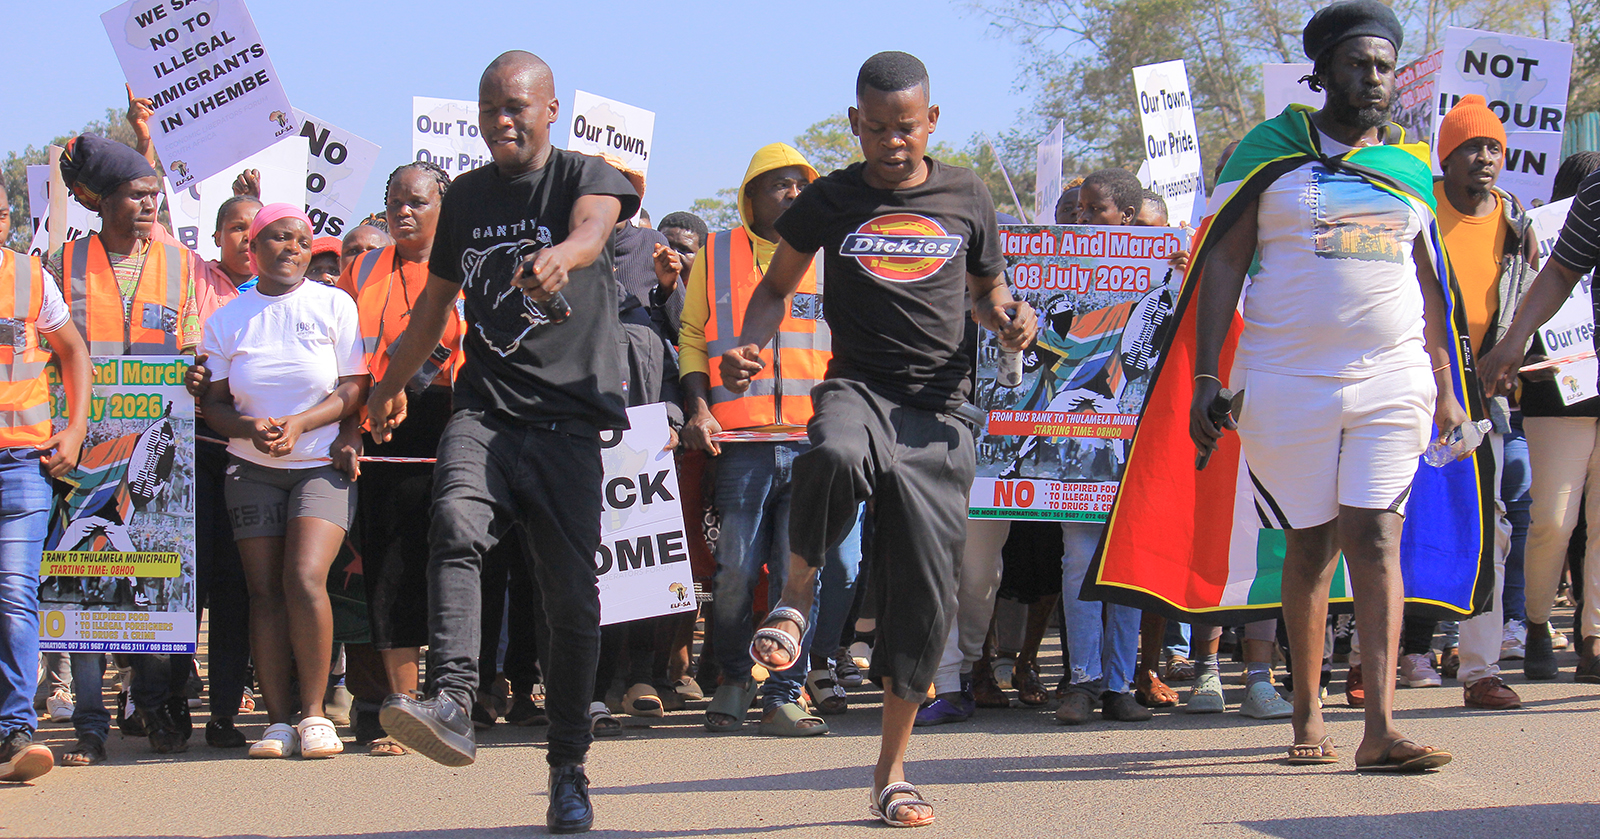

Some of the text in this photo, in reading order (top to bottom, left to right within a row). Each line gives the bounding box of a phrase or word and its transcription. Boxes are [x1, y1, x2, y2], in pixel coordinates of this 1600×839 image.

[135, 4, 167, 28] WE
[150, 12, 211, 51] NO TO
[153, 30, 236, 78] ILLEGAL
[1463, 49, 1539, 82] NOT
[147, 43, 265, 111] MMIGRANTS
[160, 69, 270, 134] IN VHEMBE
[1141, 89, 1190, 114] Our Town,
[417, 115, 478, 137] Our To
[1487, 100, 1563, 132] OUR
[300, 120, 348, 165] No
[574, 115, 647, 161] Our Town,
[1148, 130, 1196, 159] Our Pride,
[417, 149, 453, 169] Our
[1505, 148, 1547, 175] WN
[850, 237, 952, 255] Dickies
[1059, 231, 1106, 257] And
[1109, 232, 1180, 258] March
[1014, 263, 1150, 294] 08 July 2026
[1545, 329, 1573, 351] Our
[92, 360, 118, 385] nd
[122, 360, 189, 386] March
[110, 393, 163, 419] 2026
[991, 412, 1139, 426] FROM BUS RANK TO THULAMELA MUNIC
[1033, 424, 1122, 437] STARTING TIME: 08H00
[601, 469, 675, 511] CK
[993, 481, 1035, 508] NO
[1050, 483, 1118, 493] TO EXPIRED FOO
[1050, 492, 1060, 500] TO
[1062, 492, 1094, 501] ILLEGAL
[1049, 501, 1059, 509] TO
[1062, 502, 1089, 511] DRUGS
[1093, 503, 1099, 511] &
[46, 553, 67, 562] RANK
[69, 553, 78, 562] TO
[80, 553, 123, 563] THULAMELA
[125, 554, 179, 564] MUNICIPALITY
[594, 530, 687, 576] OME
[49, 564, 135, 575] STARTING TIME: 08H00
[80, 612, 150, 621] TO EXPIRED FOOD
[670, 601, 691, 609] ELF-SA
[80, 621, 174, 631] TO ILLEGAL FOREIGNERS
[80, 631, 90, 639] TO
[92, 631, 119, 639] DRUGS
[131, 632, 156, 640] CRIME
